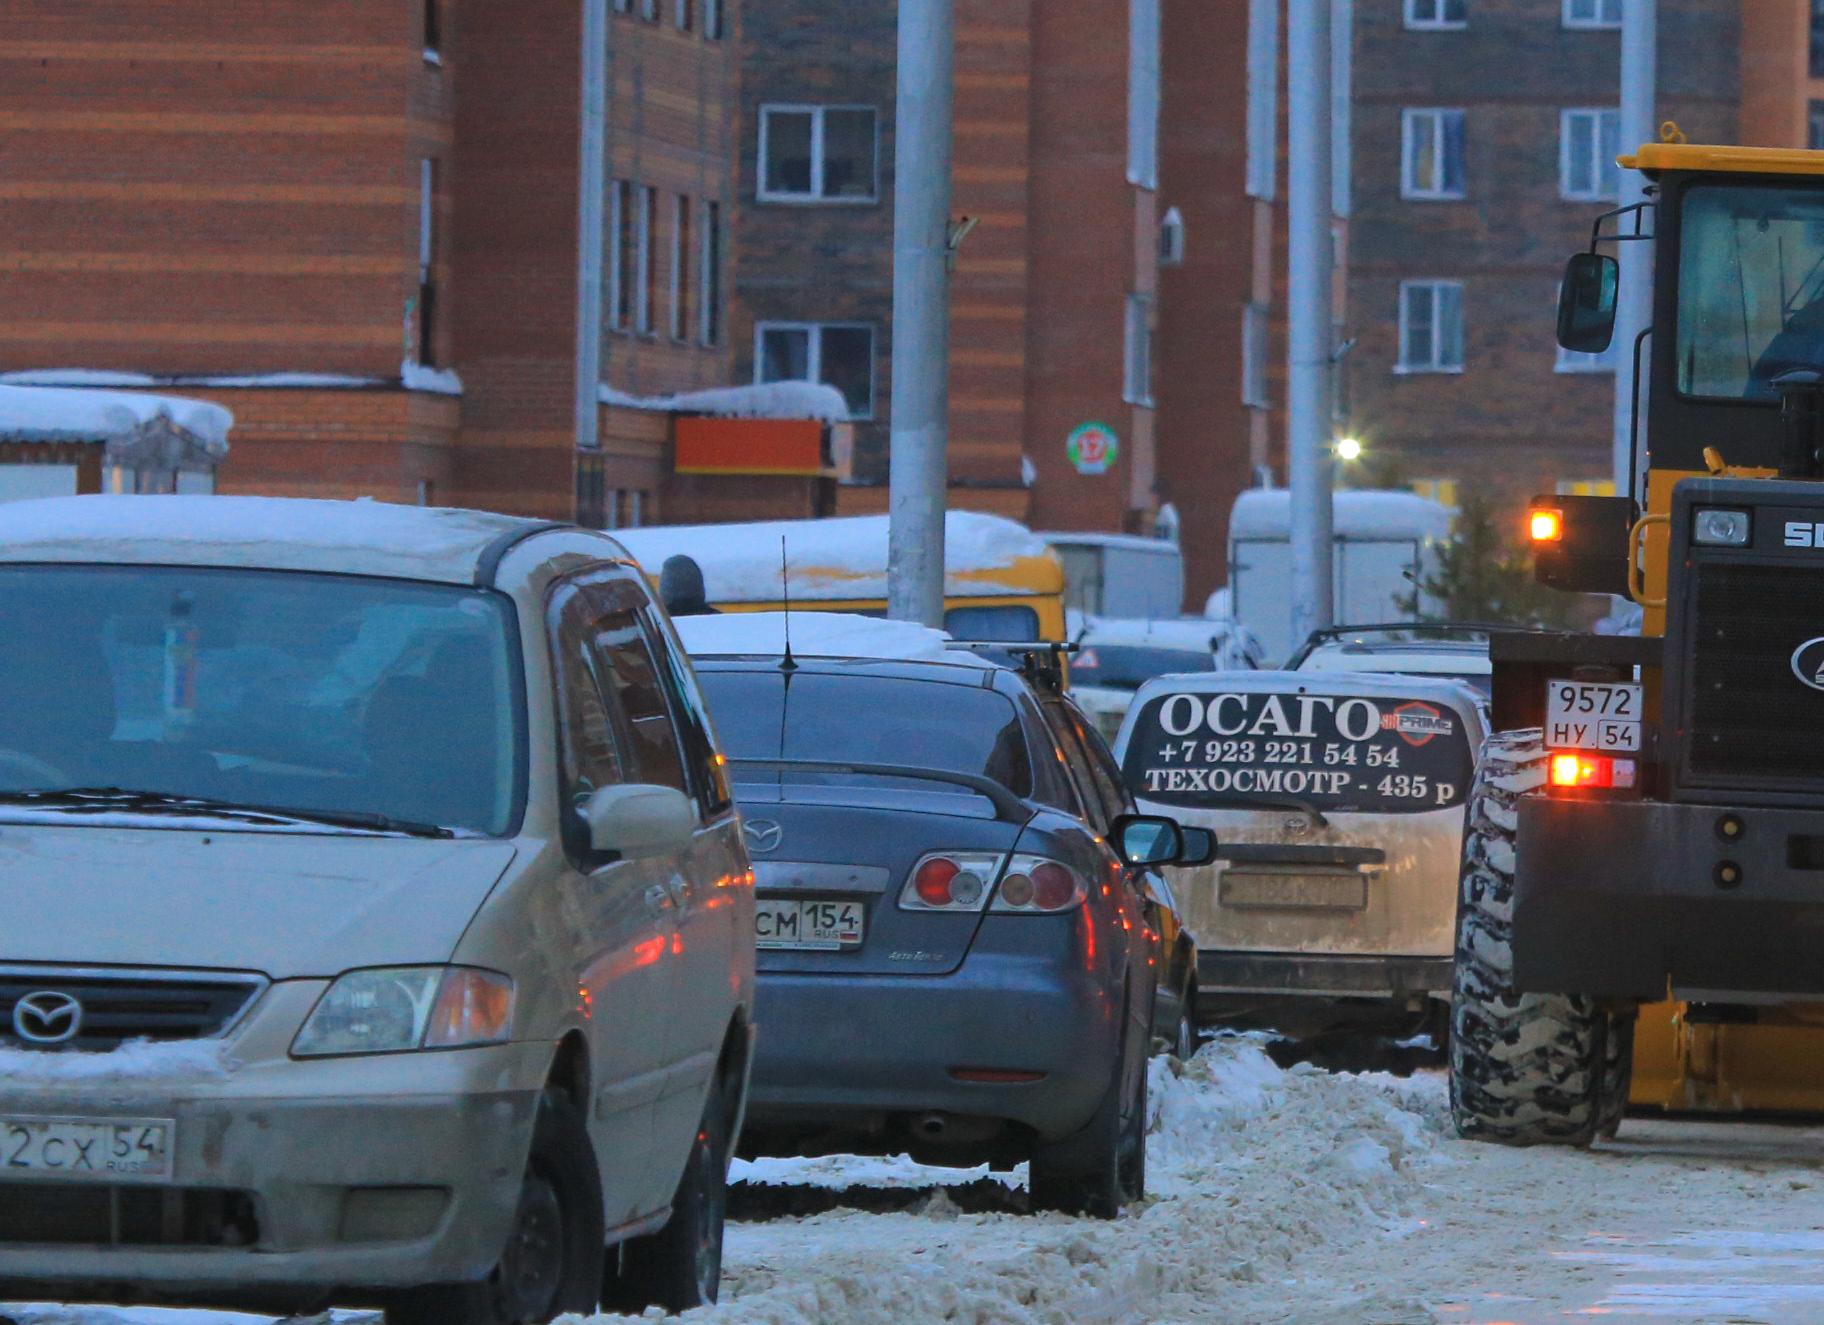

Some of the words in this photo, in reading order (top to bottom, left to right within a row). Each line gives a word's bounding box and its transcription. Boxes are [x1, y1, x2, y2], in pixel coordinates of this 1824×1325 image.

[1560, 686, 1631, 715] 9572
[1158, 694, 1381, 741] ОСАГО
[1554, 723, 1588, 744] НУ
[1605, 725, 1632, 746] 54
[1158, 741, 1198, 763] +7
[1205, 741, 1255, 763] 923
[1264, 742, 1313, 765] 221
[1324, 743, 1357, 766] 54
[1366, 745, 1400, 768] 54
[1145, 769, 1351, 795] ТЕХОСМОТР
[1377, 774, 1428, 798] 435
[1436, 782, 1455, 805] р
[805, 904, 855, 929] 154
[815, 930, 839, 938] RUS
[0, 1127, 95, 1170] 2СХ
[113, 1127, 154, 1158] 54
[106, 1161, 138, 1173] RUS
